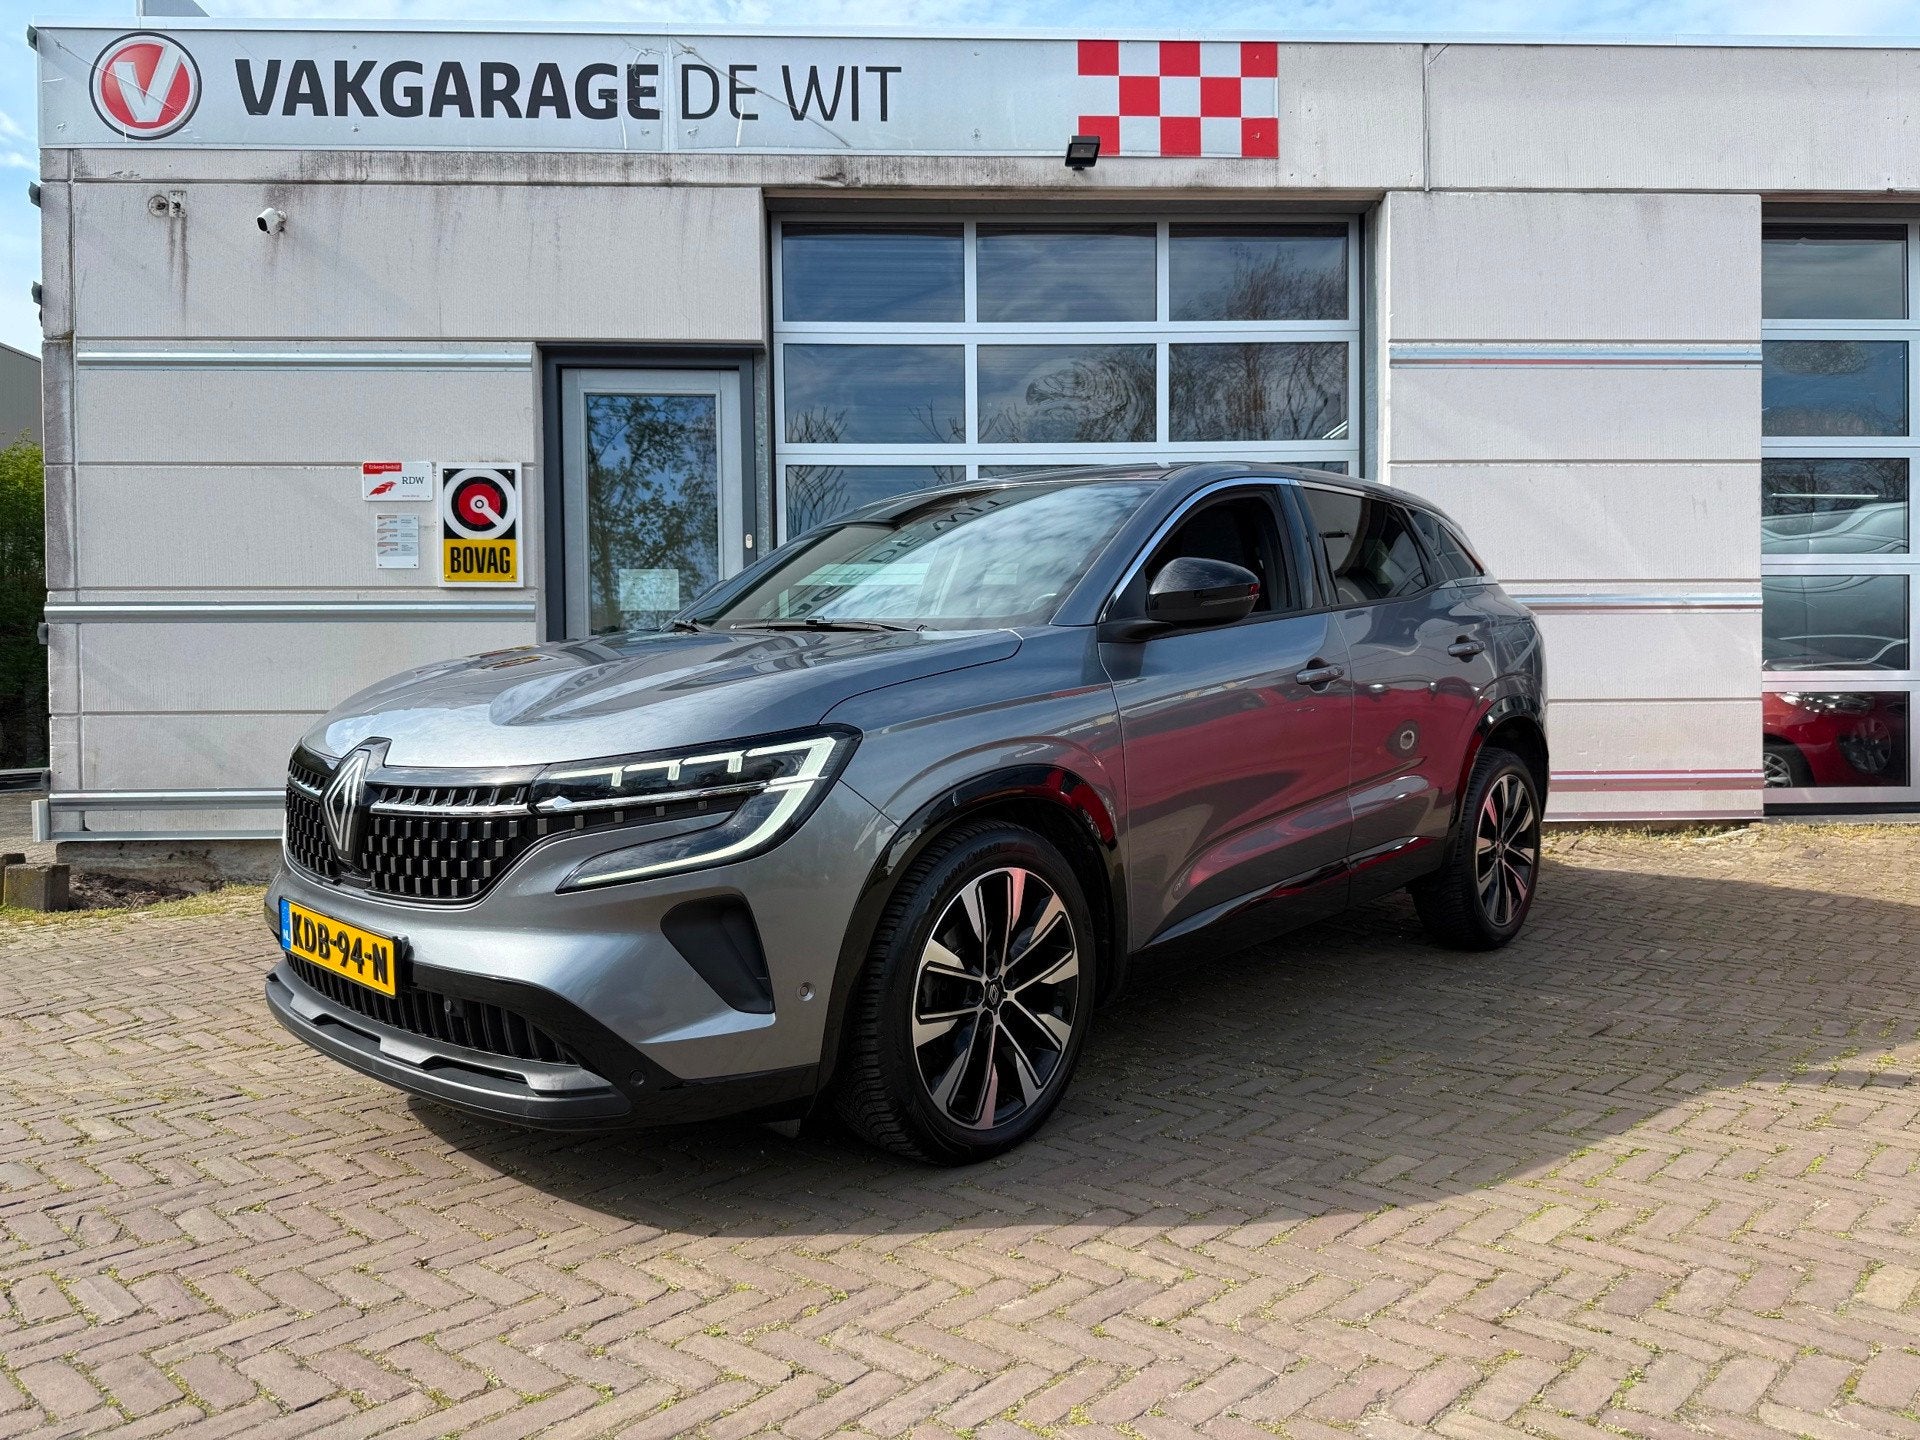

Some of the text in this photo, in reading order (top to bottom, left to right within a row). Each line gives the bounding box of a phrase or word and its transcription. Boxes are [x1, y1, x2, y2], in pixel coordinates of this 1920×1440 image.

[234, 58, 902, 121] VAKGARAGE DE WIT
[402, 476, 425, 484] RDW
[450, 546, 511, 574] BOVAG
[291, 911, 389, 986] KDB-94-N
